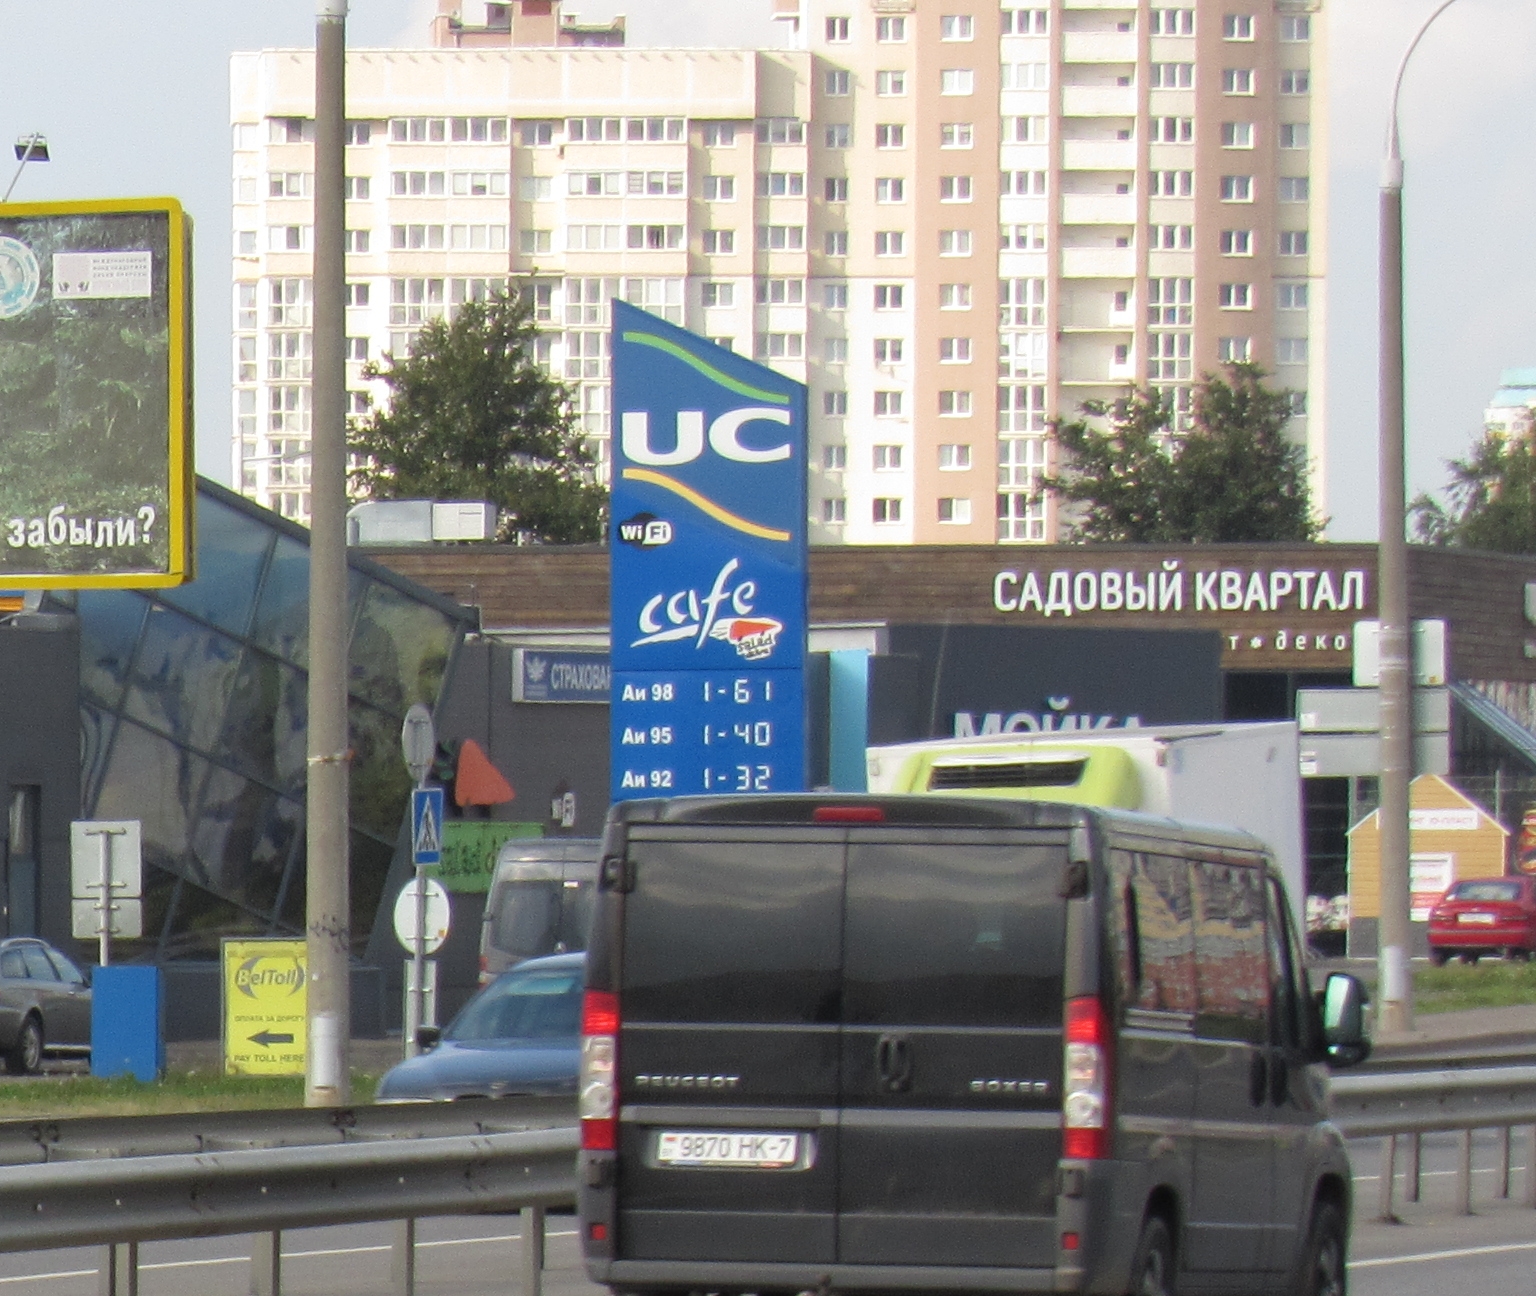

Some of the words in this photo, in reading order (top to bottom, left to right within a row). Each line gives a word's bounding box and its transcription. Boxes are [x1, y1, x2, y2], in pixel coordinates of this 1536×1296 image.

[622, 407, 791, 466] UC
[8, 504, 156, 548] забыли?
[993, 560, 1183, 616] САДОВЫЙ
[1194, 571, 1365, 611] КВАРТАЛ
[1274, 629, 1346, 651] деко
[621, 684, 646, 701] Аи
[651, 683, 674, 701] 98
[953, 696, 1145, 738] МОЙ
[621, 727, 646, 745] Аи
[650, 726, 672, 744] 95
[621, 770, 646, 788] Аи
[650, 770, 673, 788] 92
[238, 968, 297, 986] BelToll
[254, 1055, 277, 1063] TOLL
[679, 1136, 730, 1159] 9870
[736, 1137, 793, 1160] HK-7
